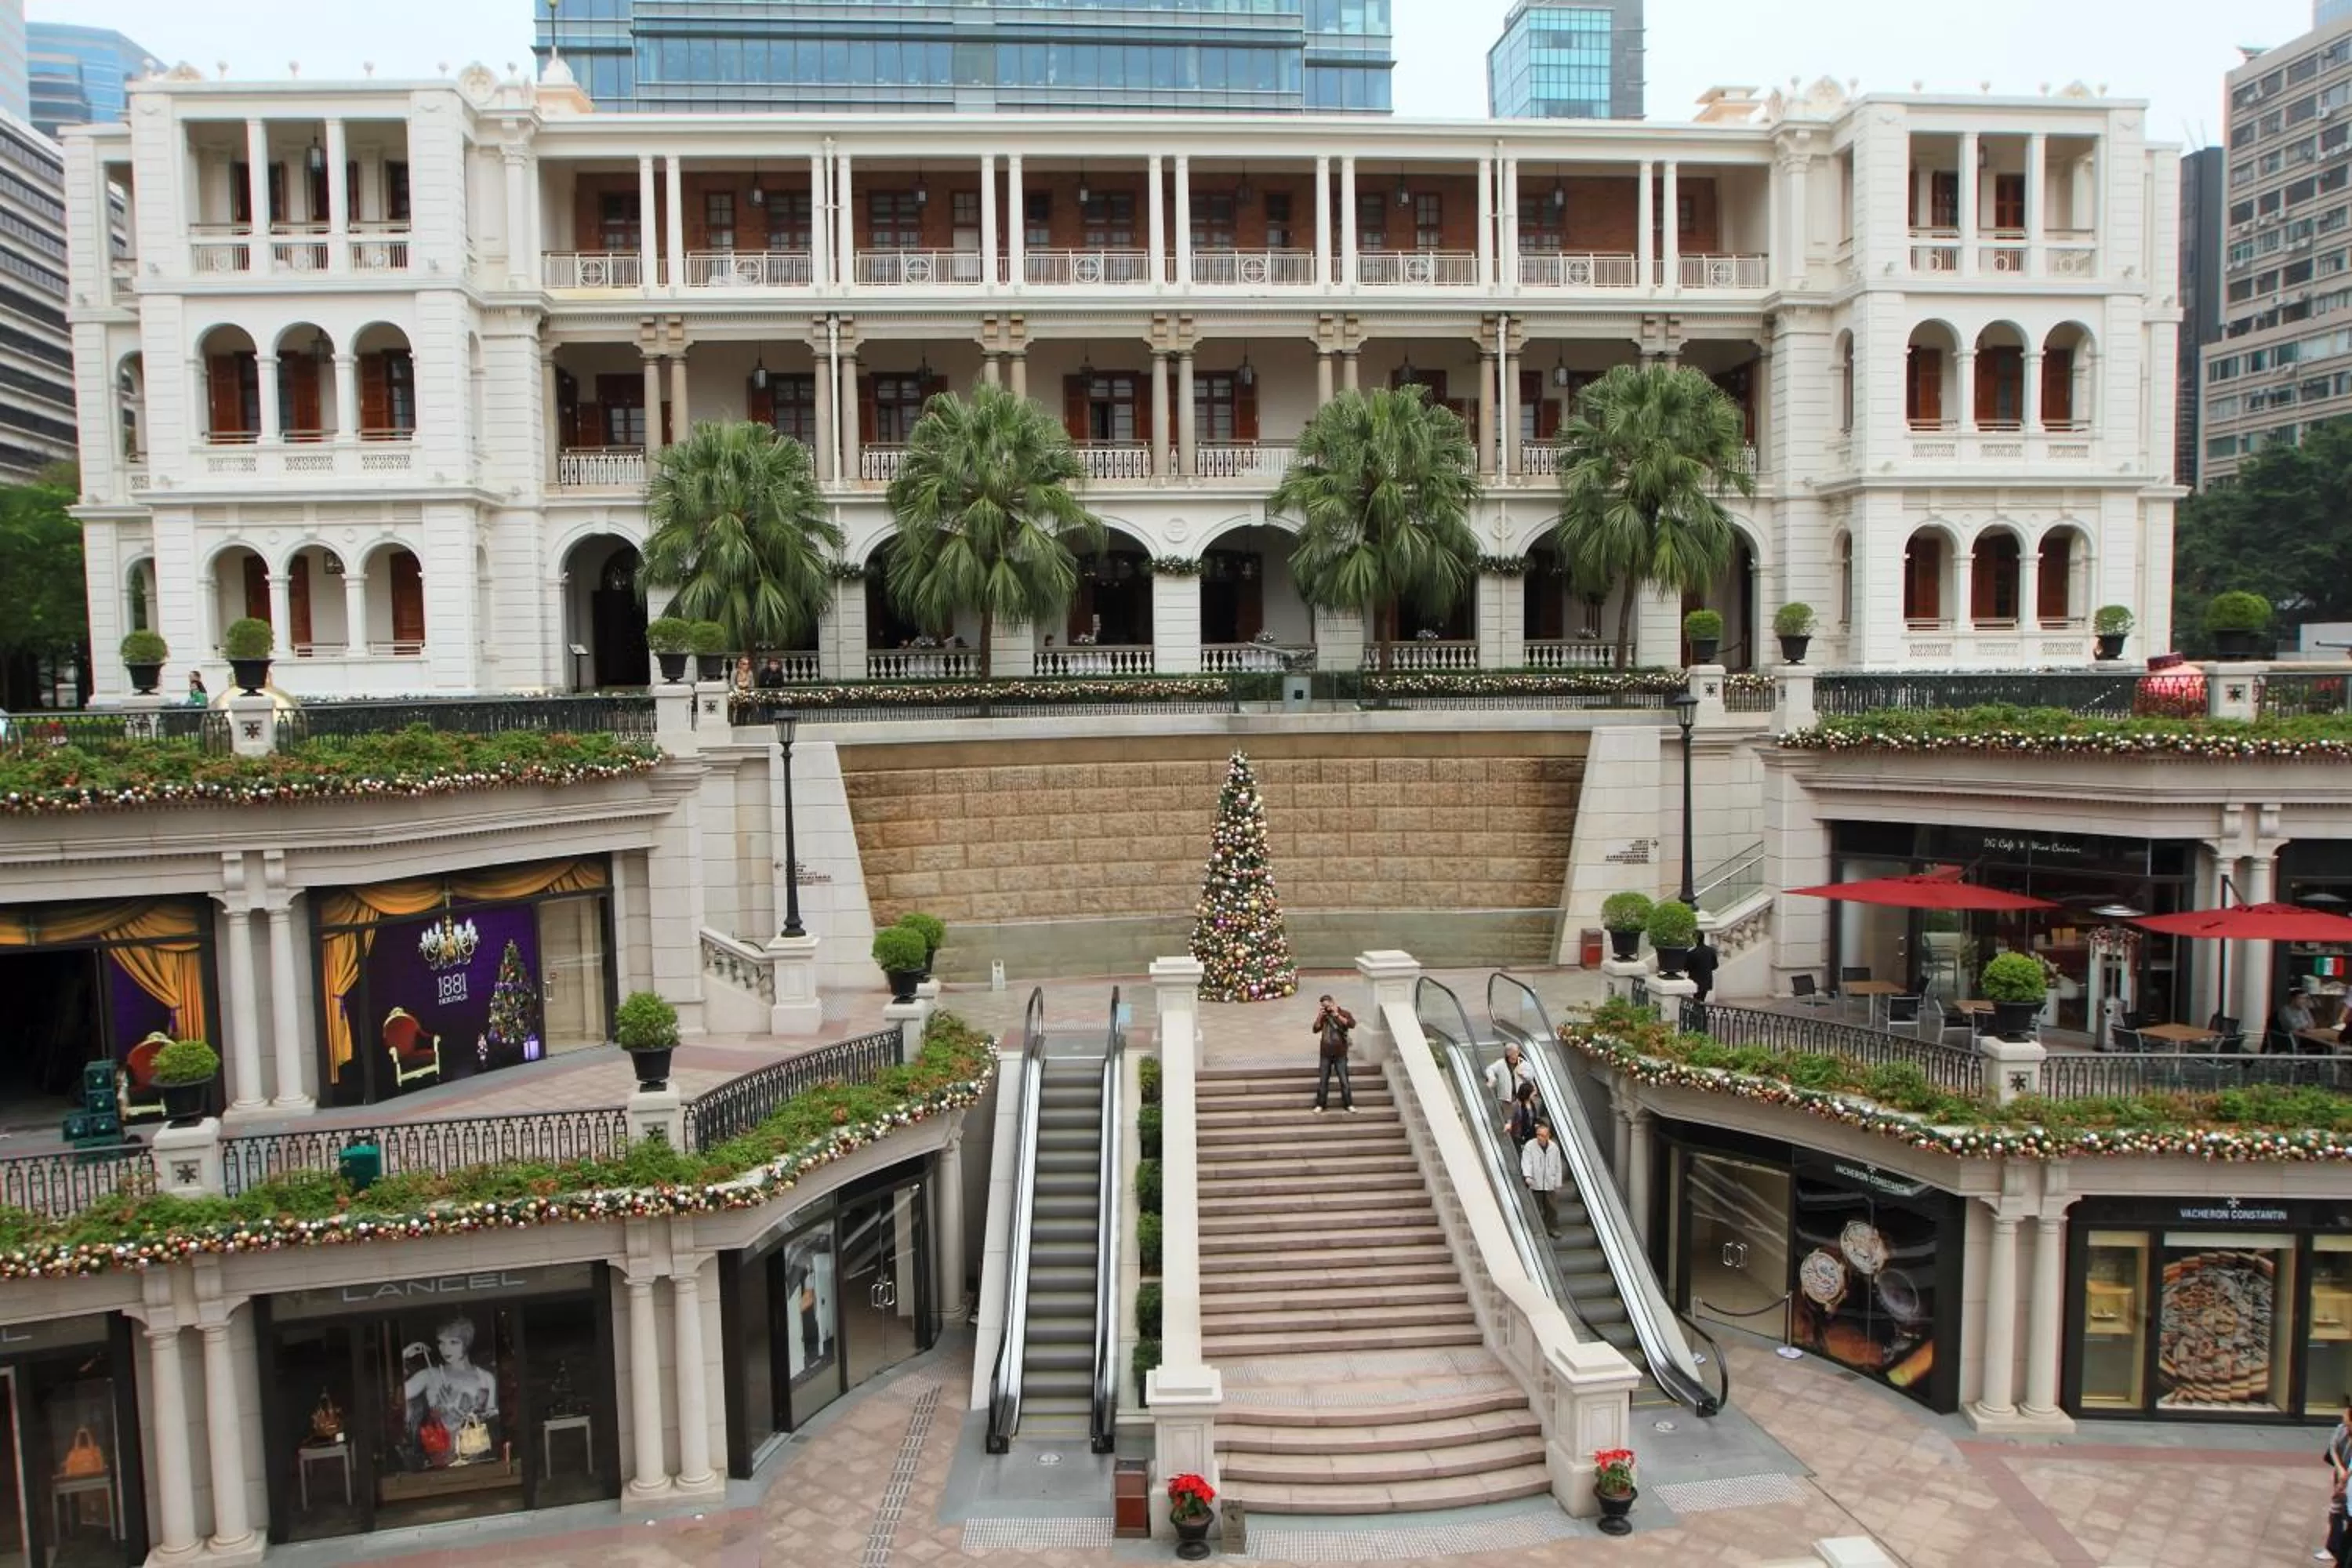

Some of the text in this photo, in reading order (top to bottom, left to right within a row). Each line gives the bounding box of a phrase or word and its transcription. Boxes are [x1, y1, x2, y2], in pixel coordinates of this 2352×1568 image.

[437, 973, 466, 997] 1881
[1835, 1163, 1868, 1183] VACHERON
[2180, 1208, 2288, 1221] VACHERON CONSTANTIN
[343, 1272, 528, 1302] LANCEL
